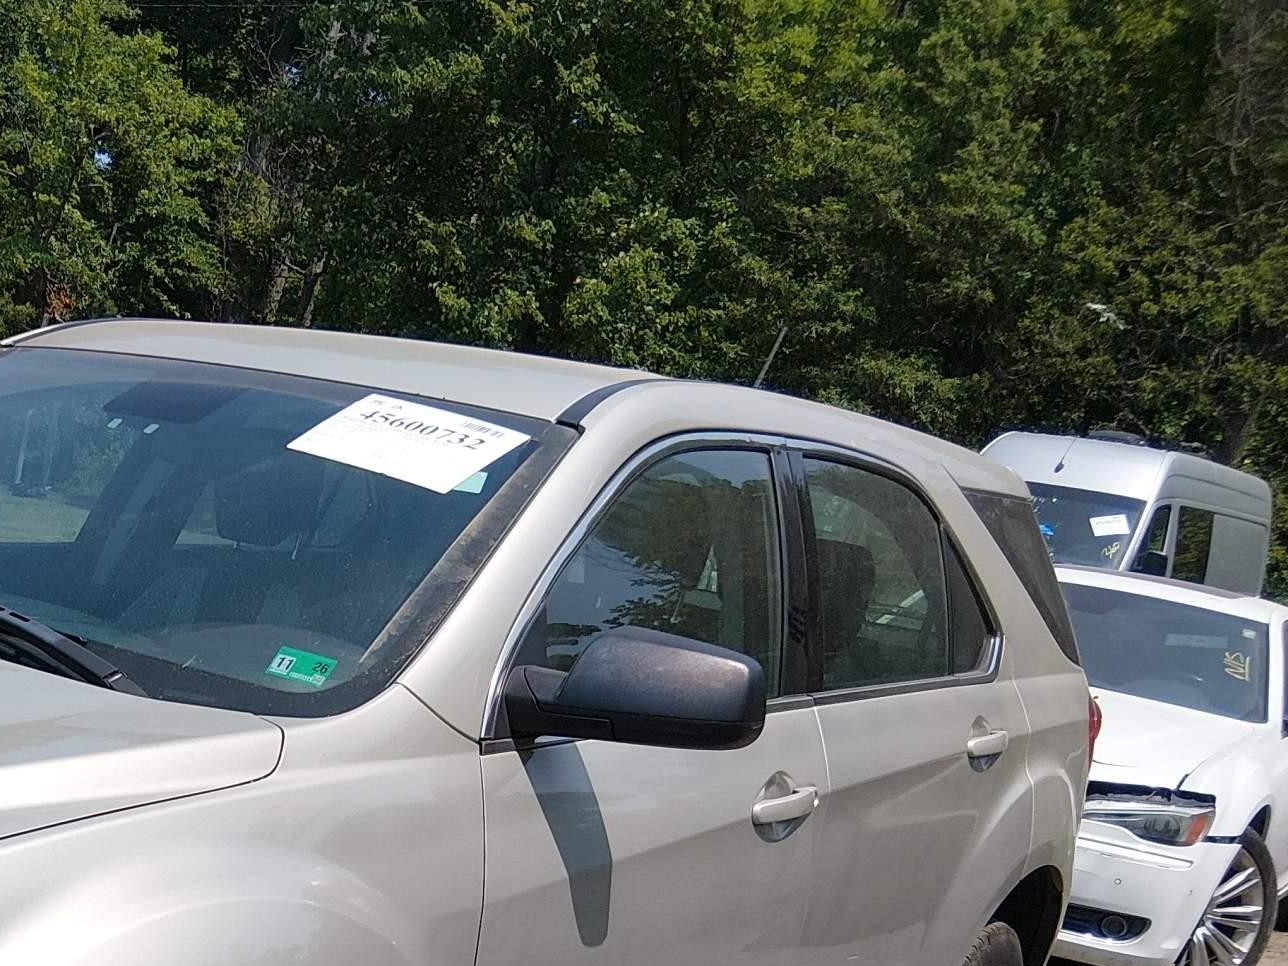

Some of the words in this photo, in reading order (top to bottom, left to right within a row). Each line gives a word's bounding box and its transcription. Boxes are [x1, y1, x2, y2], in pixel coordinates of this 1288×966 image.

[360, 410, 485, 450] 45600732
[277, 657, 294, 671] 11
[312, 662, 330, 674] 26
